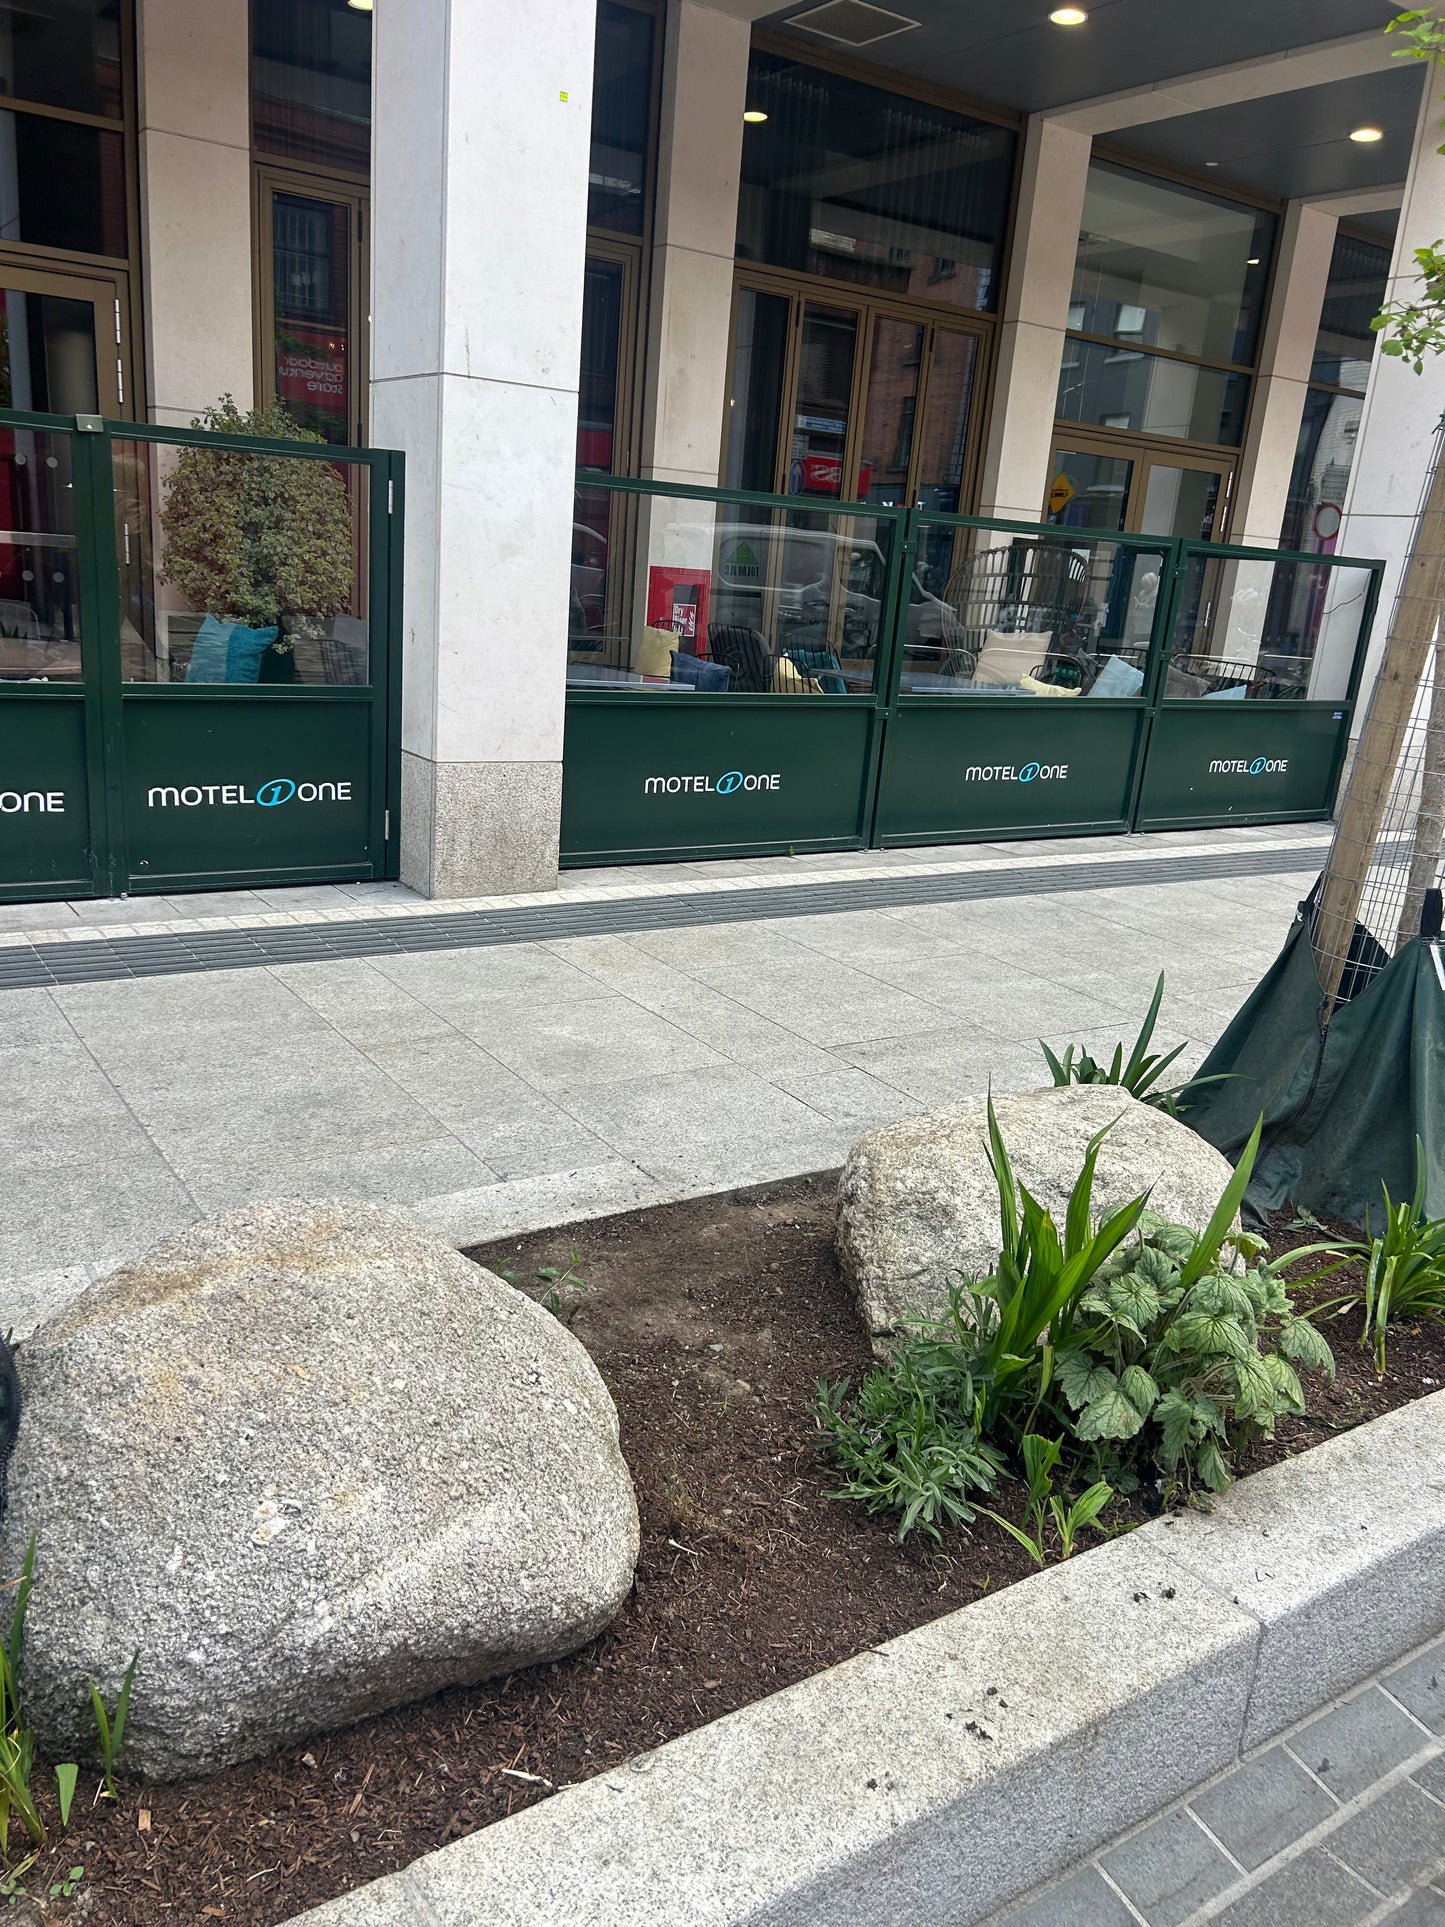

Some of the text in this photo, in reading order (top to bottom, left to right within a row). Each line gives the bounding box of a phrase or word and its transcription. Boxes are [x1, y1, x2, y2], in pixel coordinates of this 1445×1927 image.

[674, 605, 685, 617] Dry
[965, 766, 1018, 782] MOTEL
[1039, 764, 1069, 780] ONE
[1208, 759, 1250, 773] MOTEL
[1265, 759, 1289, 773] ONE
[644, 775, 716, 794] MOTEL
[743, 773, 781, 791] ONE
[0, 791, 65, 813] ONE
[147, 785, 255, 807] MOTEL
[297, 781, 352, 802] ONE
